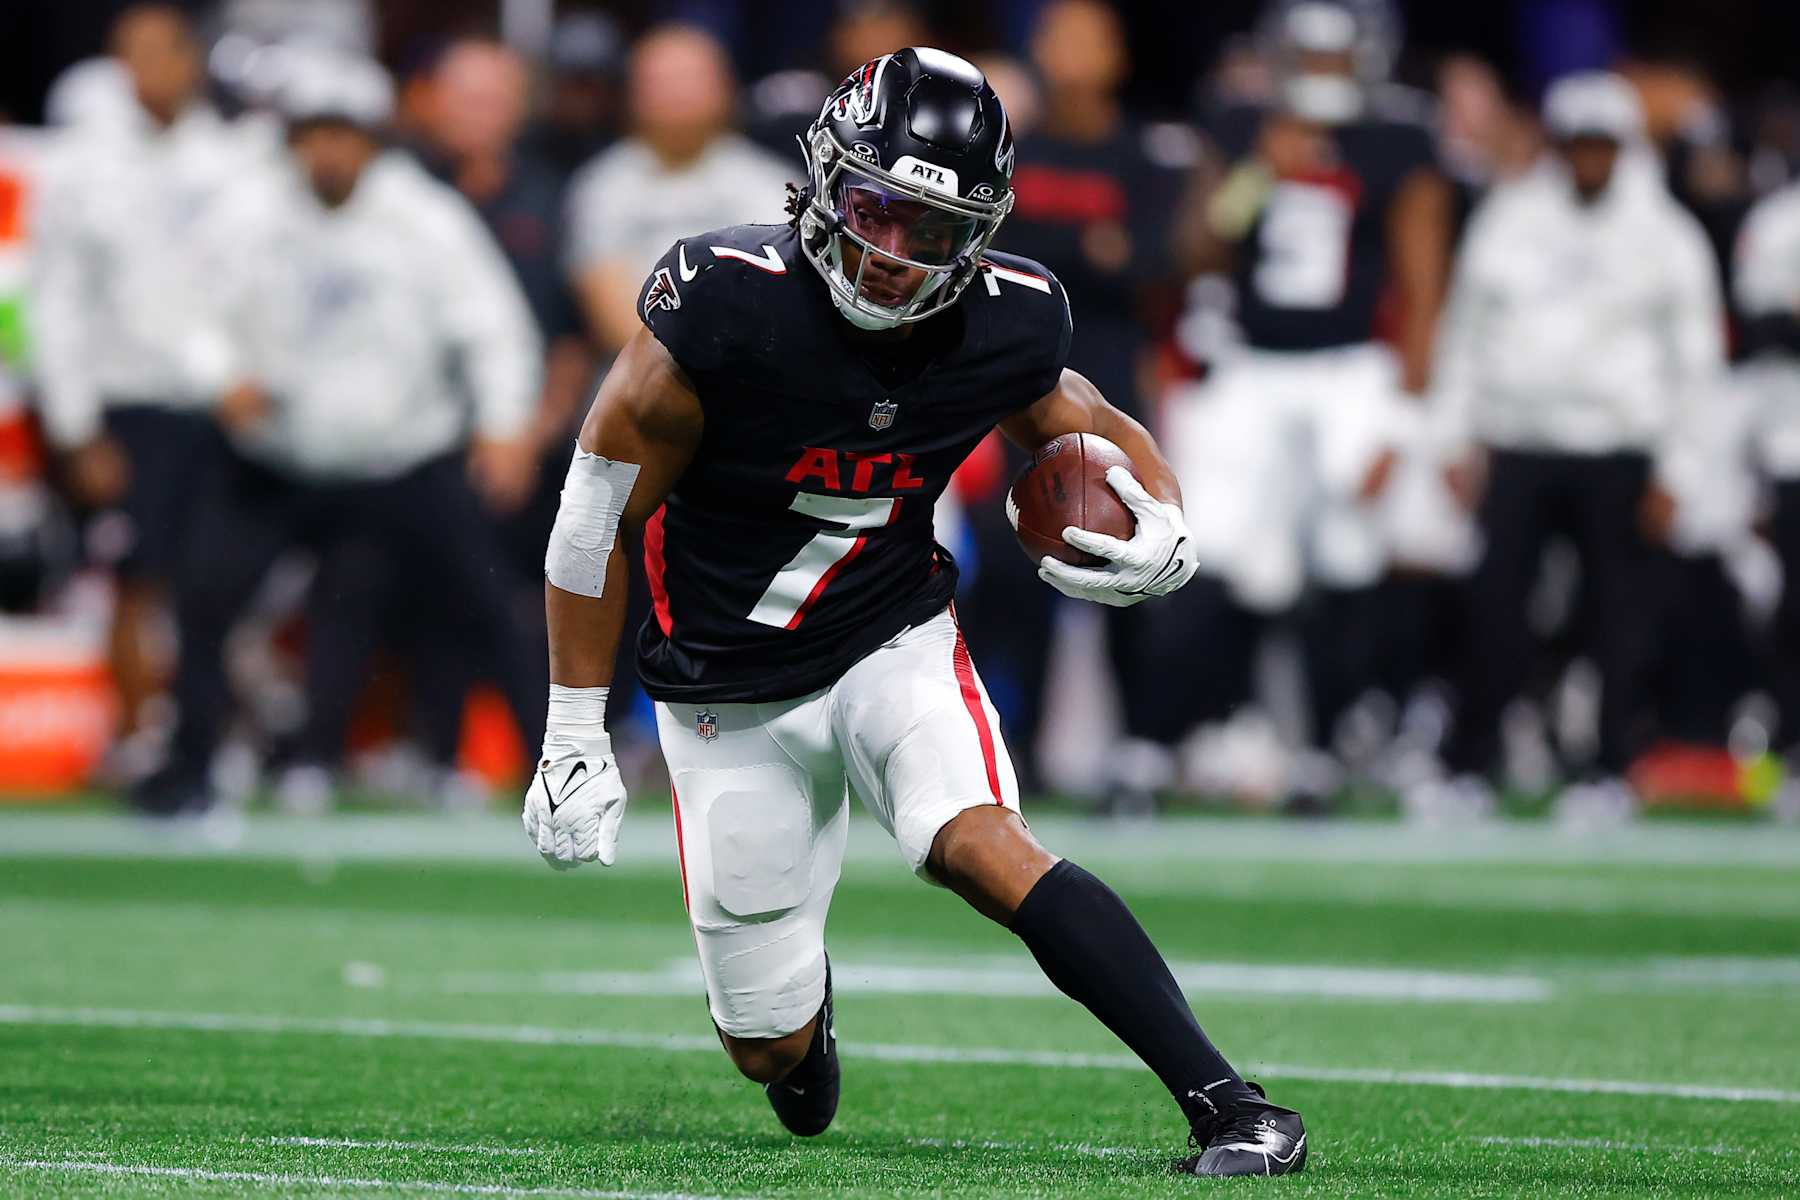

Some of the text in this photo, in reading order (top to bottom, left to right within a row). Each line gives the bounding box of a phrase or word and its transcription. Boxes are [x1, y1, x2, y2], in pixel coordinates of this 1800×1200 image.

[911, 164, 945, 184] ATL
[709, 245, 787, 275] 7
[784, 447, 925, 492] ATL
[746, 491, 903, 630] 7
[699, 724, 716, 736] NFL
